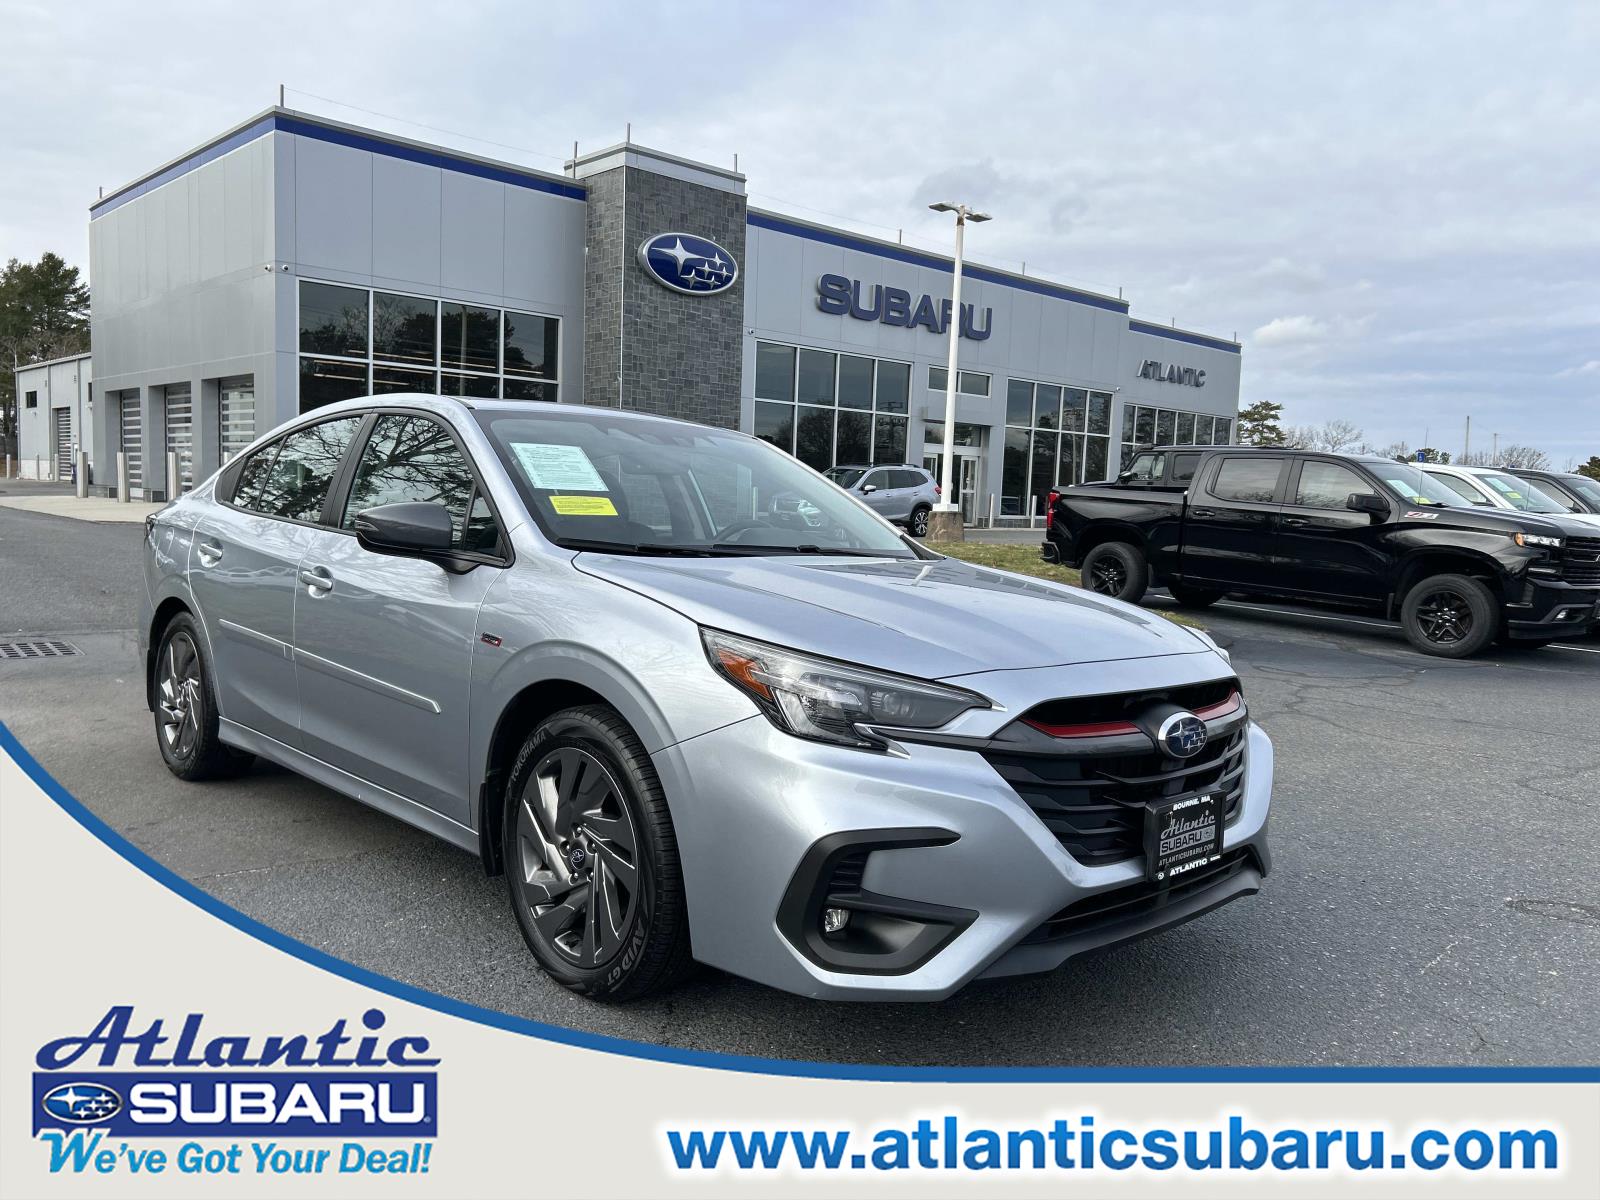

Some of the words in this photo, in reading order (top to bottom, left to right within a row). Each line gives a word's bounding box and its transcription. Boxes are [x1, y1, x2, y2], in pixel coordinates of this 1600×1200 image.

[816, 273, 993, 341] SUBARU
[1136, 359, 1206, 387] ATLANTIC
[510, 732, 546, 781] YOKOHAMA
[1160, 810, 1216, 839] Atlantic
[1158, 843, 1215, 867] ATLANTICSUBARU.COM
[1161, 831, 1202, 855] SUBARU
[1169, 858, 1208, 877] ATLANTIC
[621, 918, 645, 971] AVID
[607, 969, 621, 985] GT
